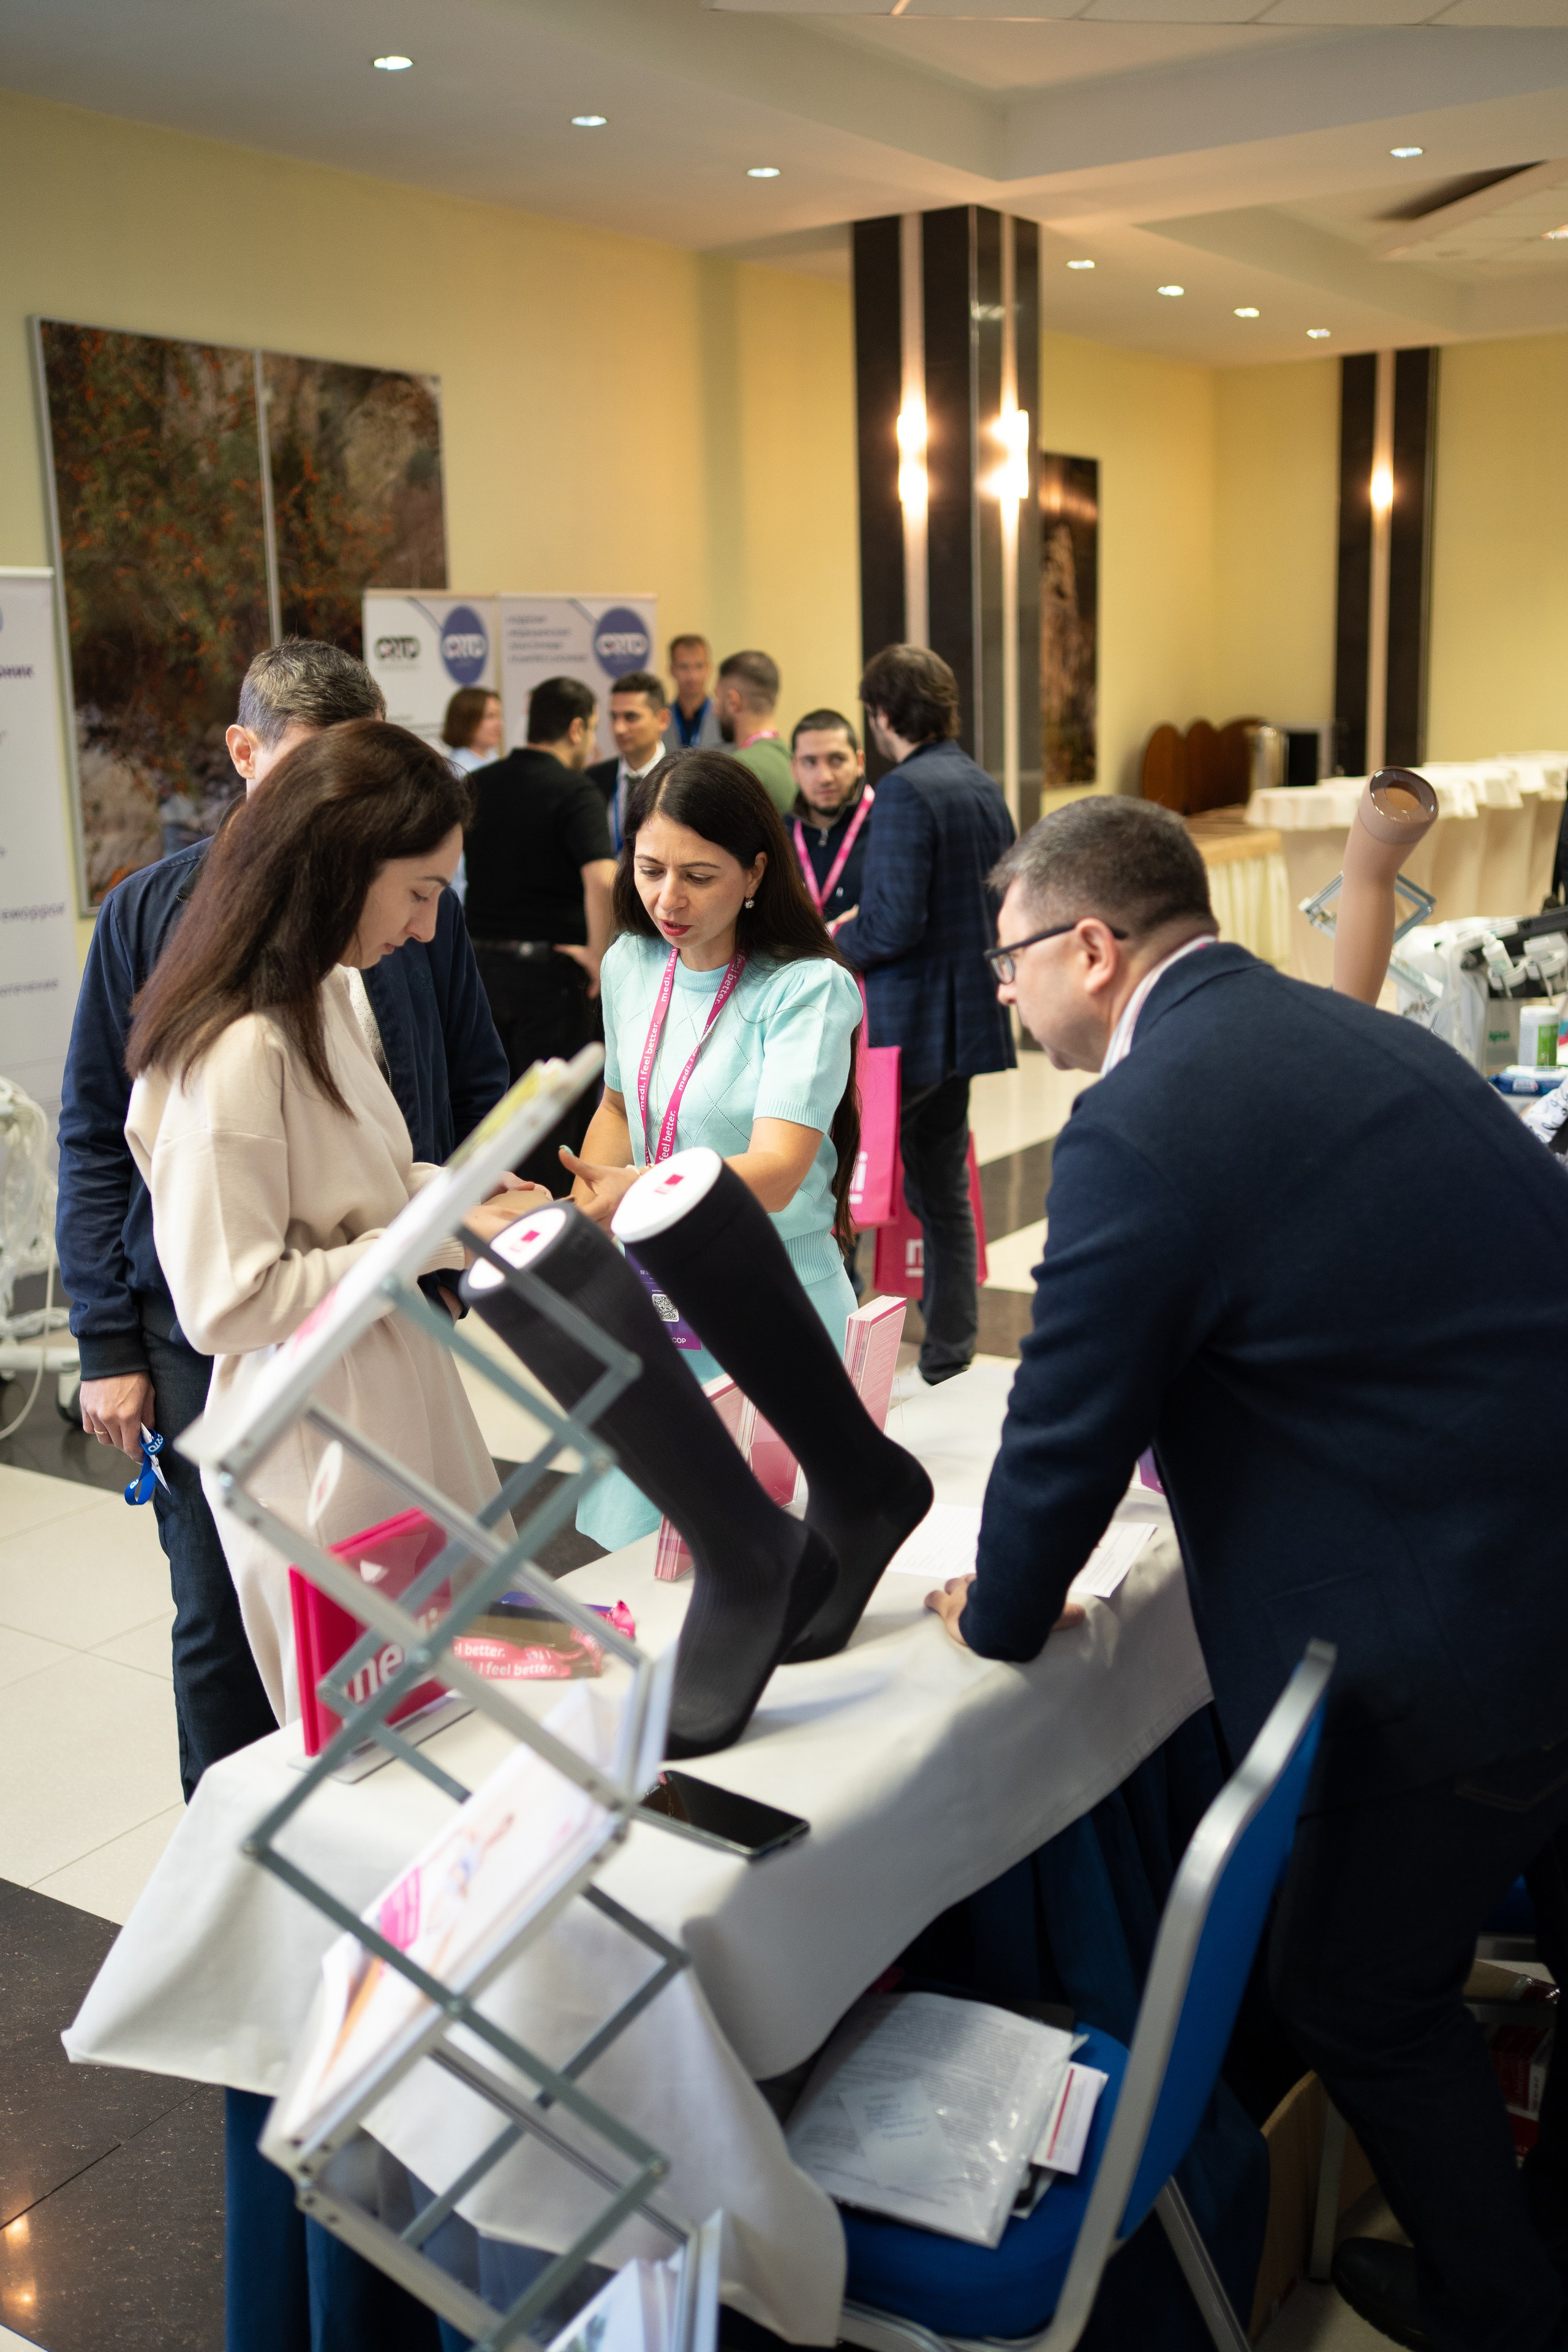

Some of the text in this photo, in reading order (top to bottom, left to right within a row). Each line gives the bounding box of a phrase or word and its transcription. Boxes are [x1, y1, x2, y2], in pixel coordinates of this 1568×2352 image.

[661, 974, 671, 1002] medi.
[714, 973, 737, 1005] better.
[645, 1020, 660, 1055] better.
[640, 1055, 651, 1076] feel
[678, 1063, 692, 1091] medi.
[658, 1110, 676, 1162] feel better.
[464, 1642, 505, 1658] better.
[486, 1660, 511, 1676] feel
[513, 1662, 557, 1676] better.
